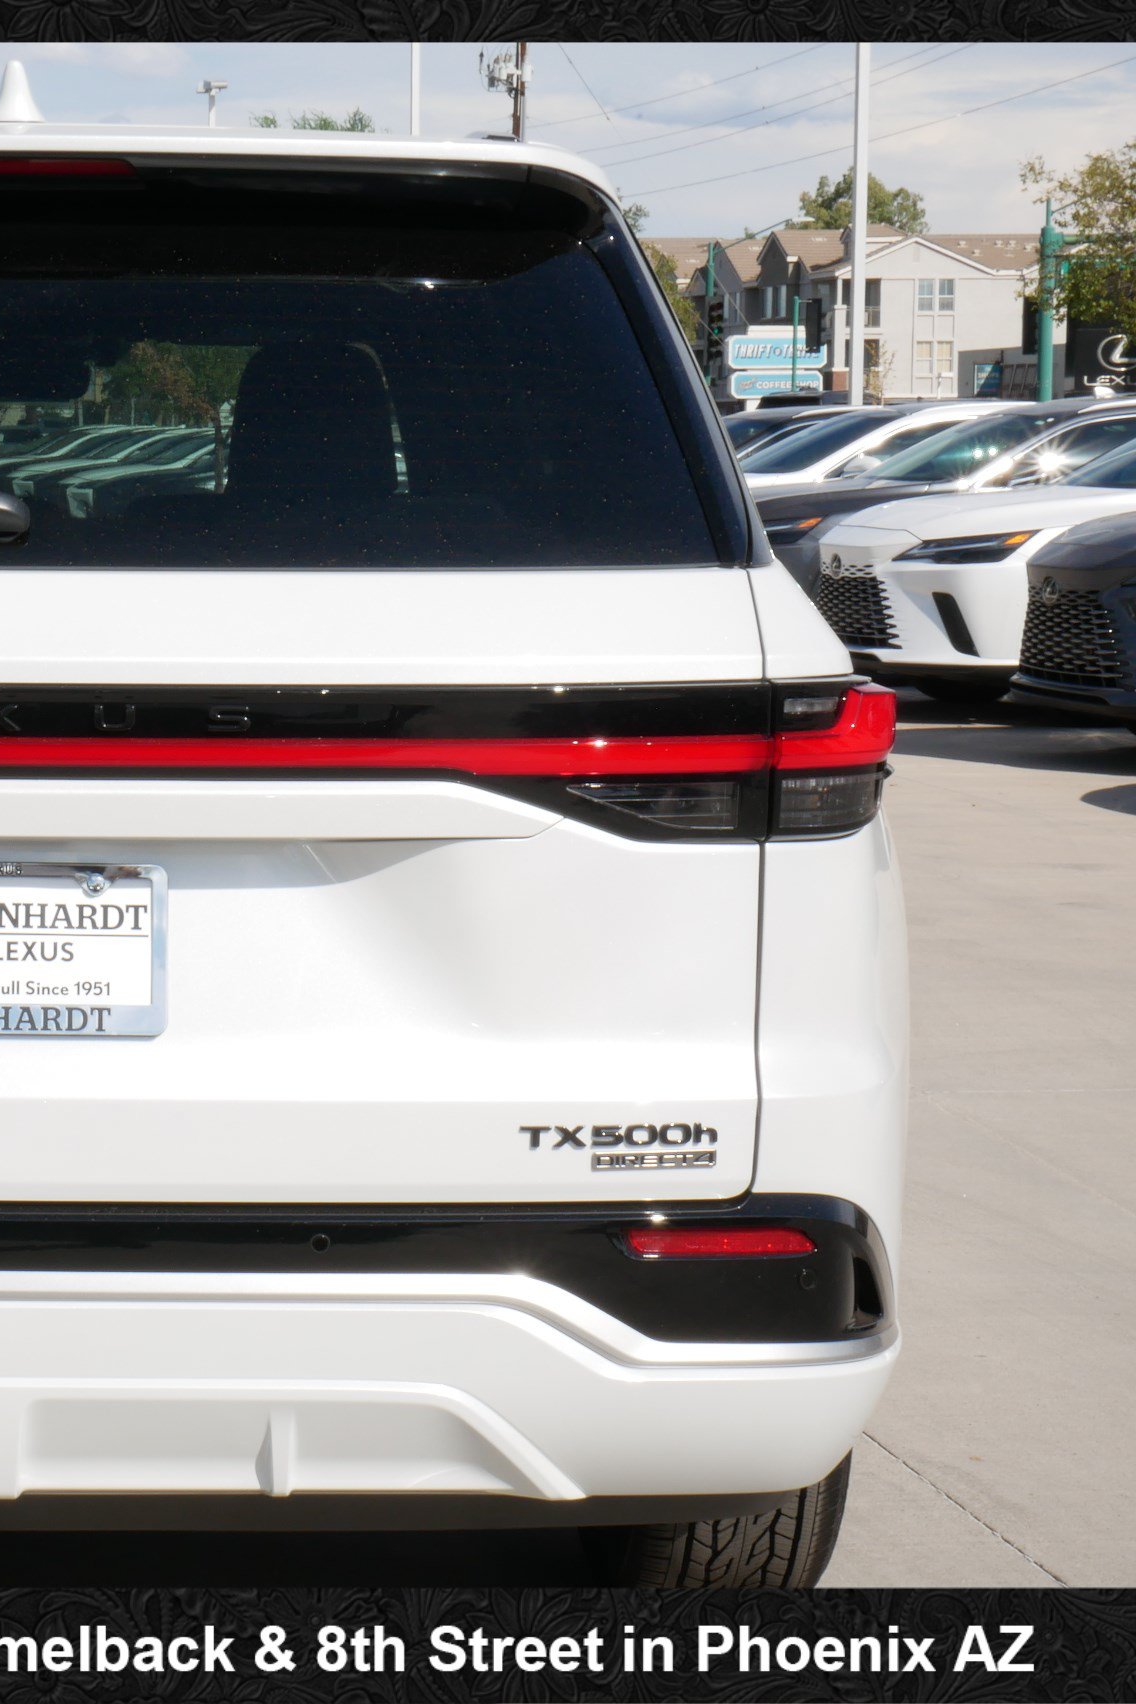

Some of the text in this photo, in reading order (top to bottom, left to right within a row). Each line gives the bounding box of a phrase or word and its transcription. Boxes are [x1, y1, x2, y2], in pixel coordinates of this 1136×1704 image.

[735, 343, 772, 359] THRIFT
[756, 381, 792, 389] COFFEE
[1083, 375, 1136, 386] LEX
[25, 981, 69, 996] Since
[74, 981, 111, 996] 1951
